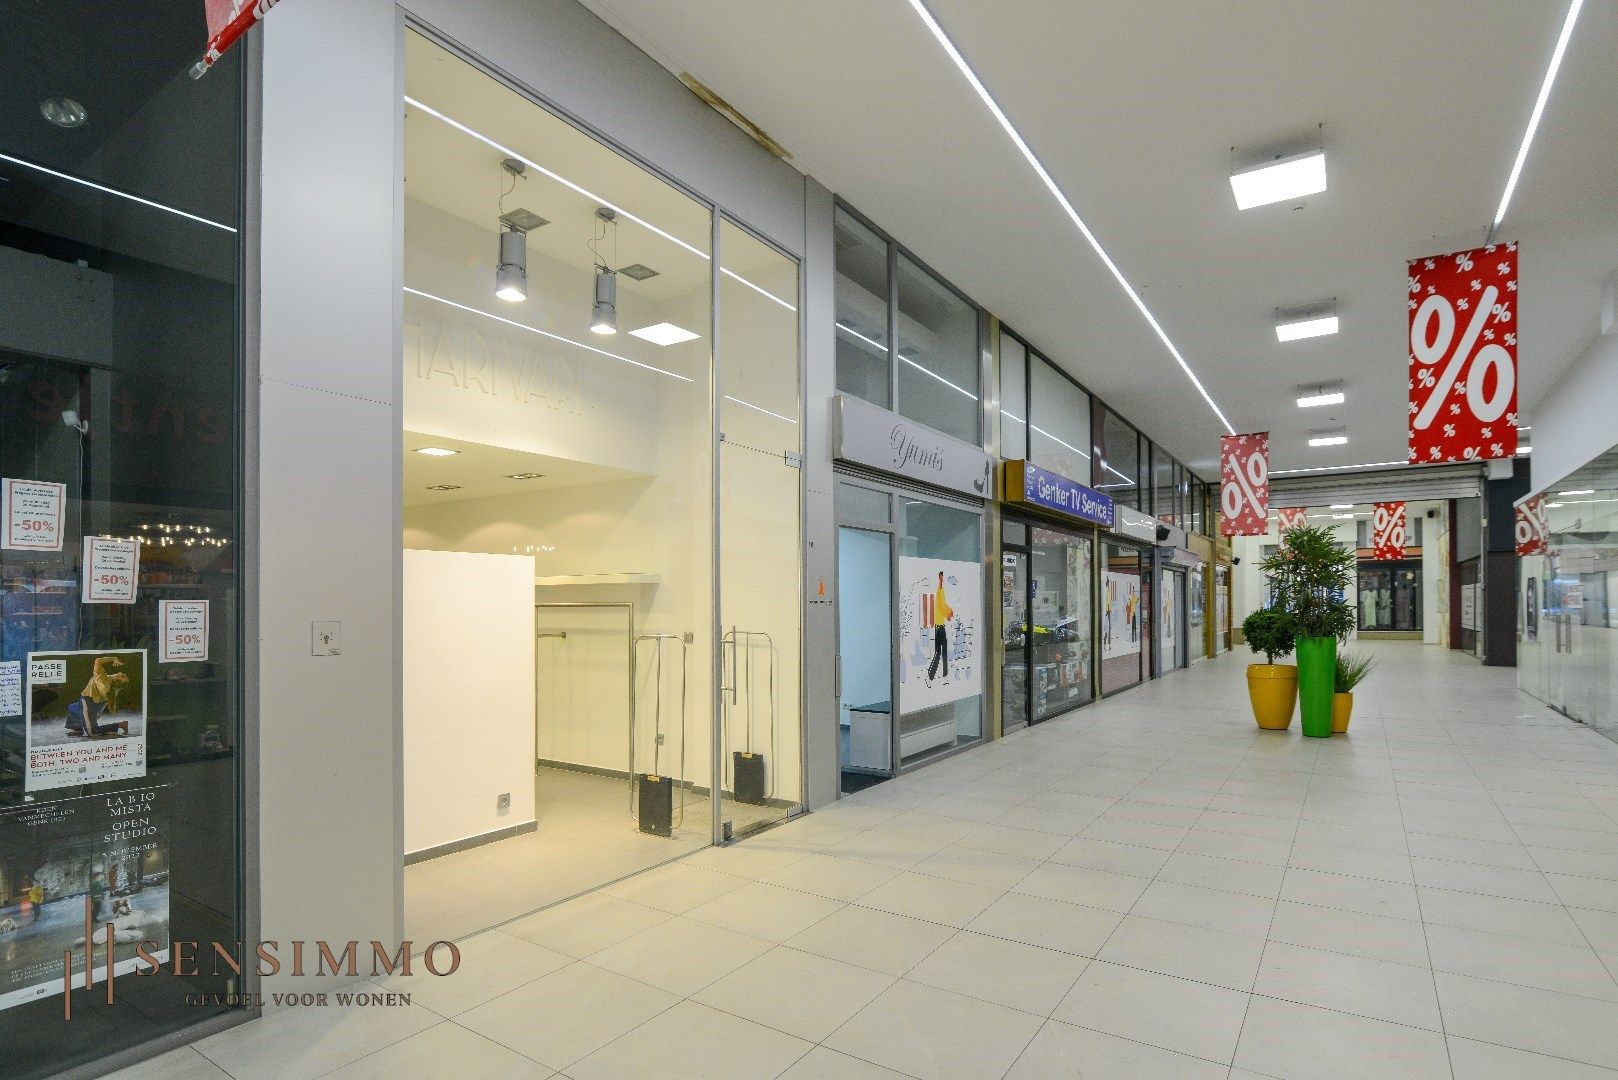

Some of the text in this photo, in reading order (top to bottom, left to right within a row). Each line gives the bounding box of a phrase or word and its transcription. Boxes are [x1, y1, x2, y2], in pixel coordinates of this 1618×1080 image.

[1038, 476, 1070, 506] Genker
[1070, 488, 1081, 510] TV
[1082, 493, 1107, 519] Service
[13, 519, 54, 532] -50%
[94, 574, 129, 586] -50%
[169, 634, 201, 645] -50%
[75, 748, 93, 756] YOU
[110, 803, 151, 816] MISTA
[112, 817, 149, 831] OPEN
[103, 826, 157, 843] STUDIO
